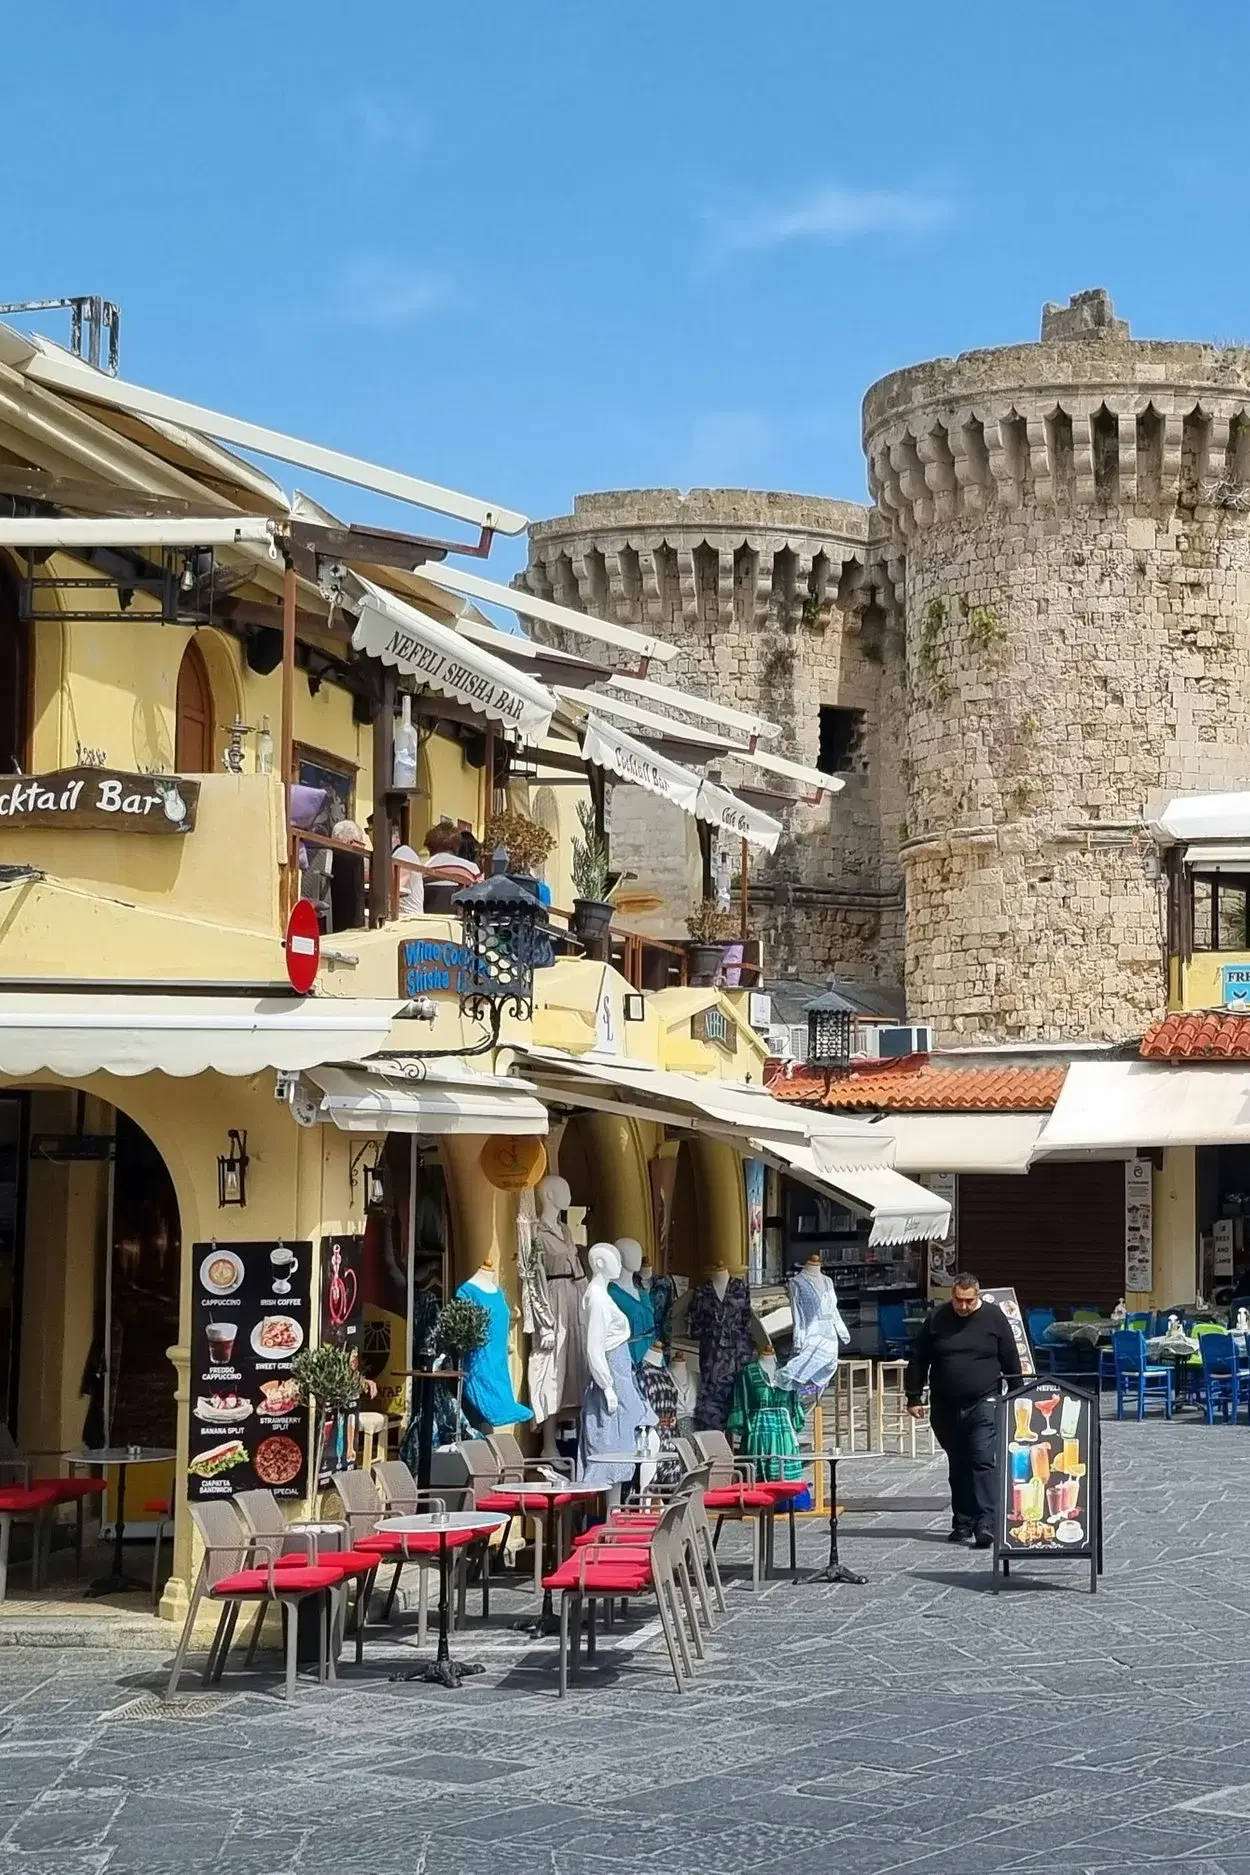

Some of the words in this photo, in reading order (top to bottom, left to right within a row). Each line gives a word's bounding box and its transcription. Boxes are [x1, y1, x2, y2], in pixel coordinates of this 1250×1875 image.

[384, 631, 445, 676] NEFELI
[442, 662, 496, 705] SHISHA
[494, 688, 525, 720] BAR
[0, 780, 85, 816] cktail
[96, 780, 162, 815] Bar
[405, 940, 441, 967] Wine
[201, 1298, 242, 1306] CAPPUCCINO
[277, 1298, 302, 1306] COFFEE
[255, 1363, 277, 1371] SWEET
[201, 1373, 242, 1381] CAPPUCCINO
[260, 1417, 302, 1425] STRAWBERRY
[200, 1427, 227, 1435] BANANA
[227, 1427, 245, 1435] SPLIT
[199, 1486, 233, 1494] SANDWICH
[273, 1488, 300, 1496] SPECIAL
